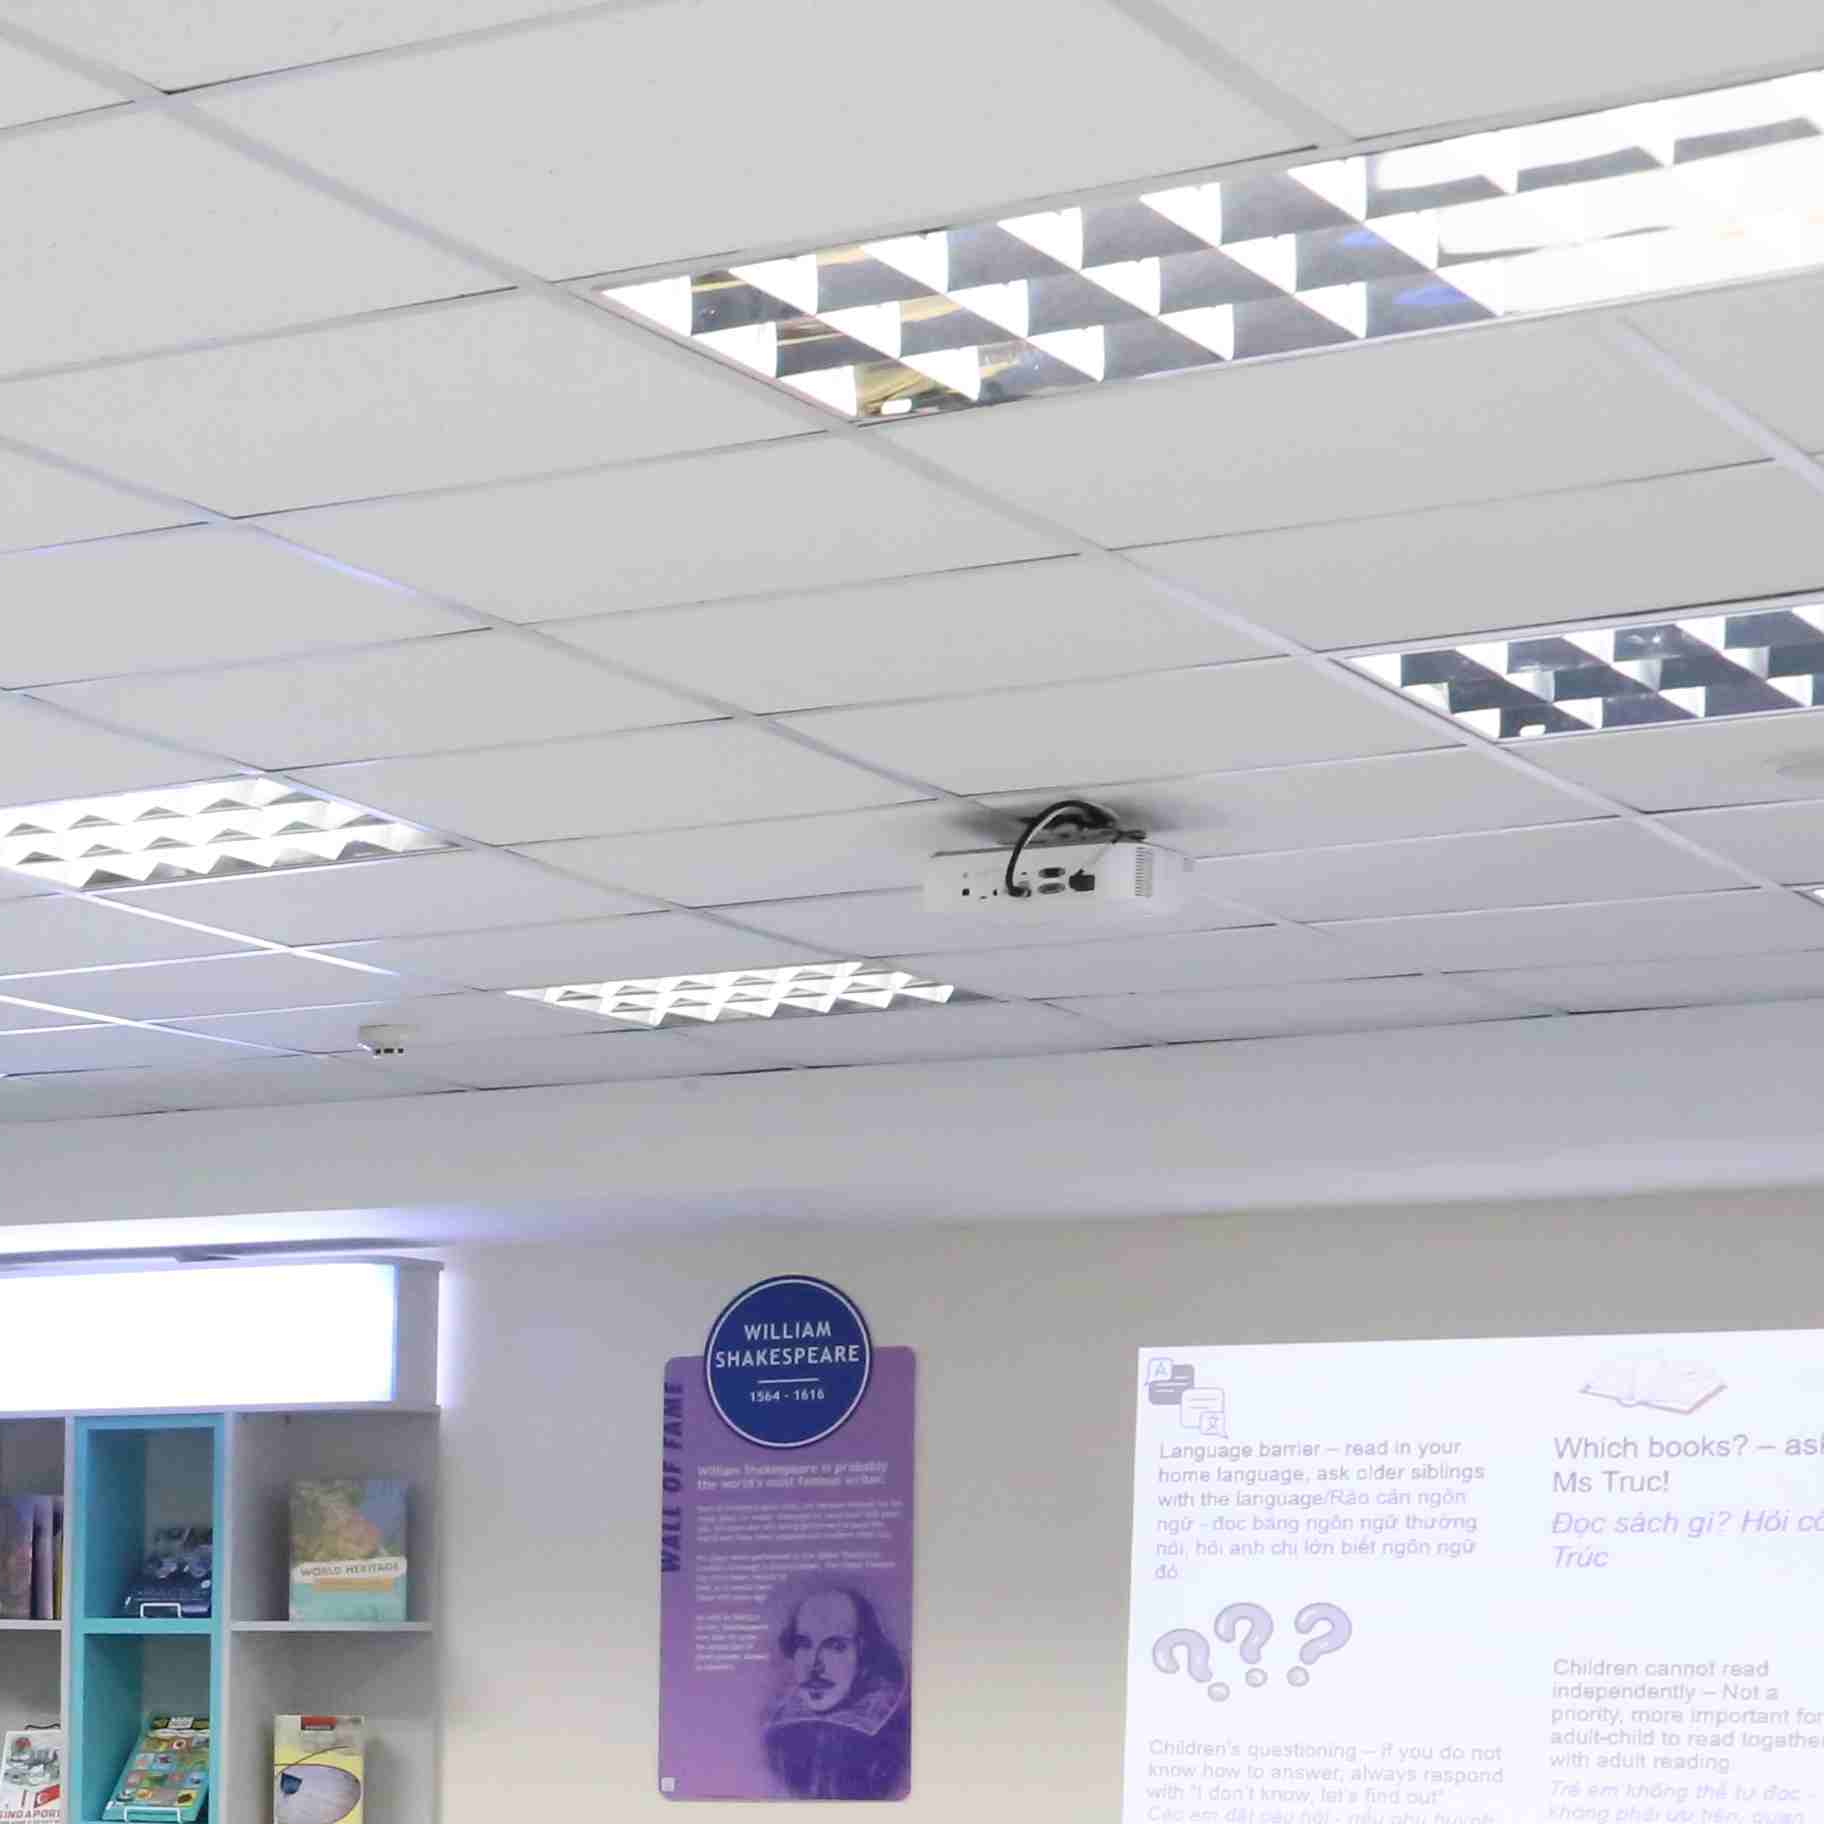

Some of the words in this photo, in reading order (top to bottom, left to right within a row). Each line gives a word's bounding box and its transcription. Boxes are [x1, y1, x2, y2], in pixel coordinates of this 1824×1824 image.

[744, 1320, 832, 1341] WILLIAM
[715, 1345, 860, 1368] SHAKESPEARE
[750, 1390, 780, 1401] 1564
[793, 1388, 825, 1400] 1616
[1159, 1441, 1252, 1461] Language
[1345, 1441, 1388, 1457] read
[1418, 1441, 1461, 1458] your
[1553, 1436, 1638, 1459] Which
[1649, 1434, 1749, 1458] books?
[1159, 1468, 1210, 1484] home
[1317, 1465, 1350, 1481] ask
[1411, 1464, 1485, 1483] siblings
[1553, 1472, 1592, 1492] Ms
[1603, 1471, 1669, 1492] Truc!
[1158, 1492, 1194, 1508] with
[1200, 1491, 1230, 1507] the
[1553, 1658, 1639, 1676] Children
[1722, 1660, 1769, 1676] read
[1552, 1682, 1695, 1703] independently
[1721, 1684, 1760, 1700] Not
[1688, 1732, 1733, 1746] read
[1549, 1752, 1590, 1768] with
